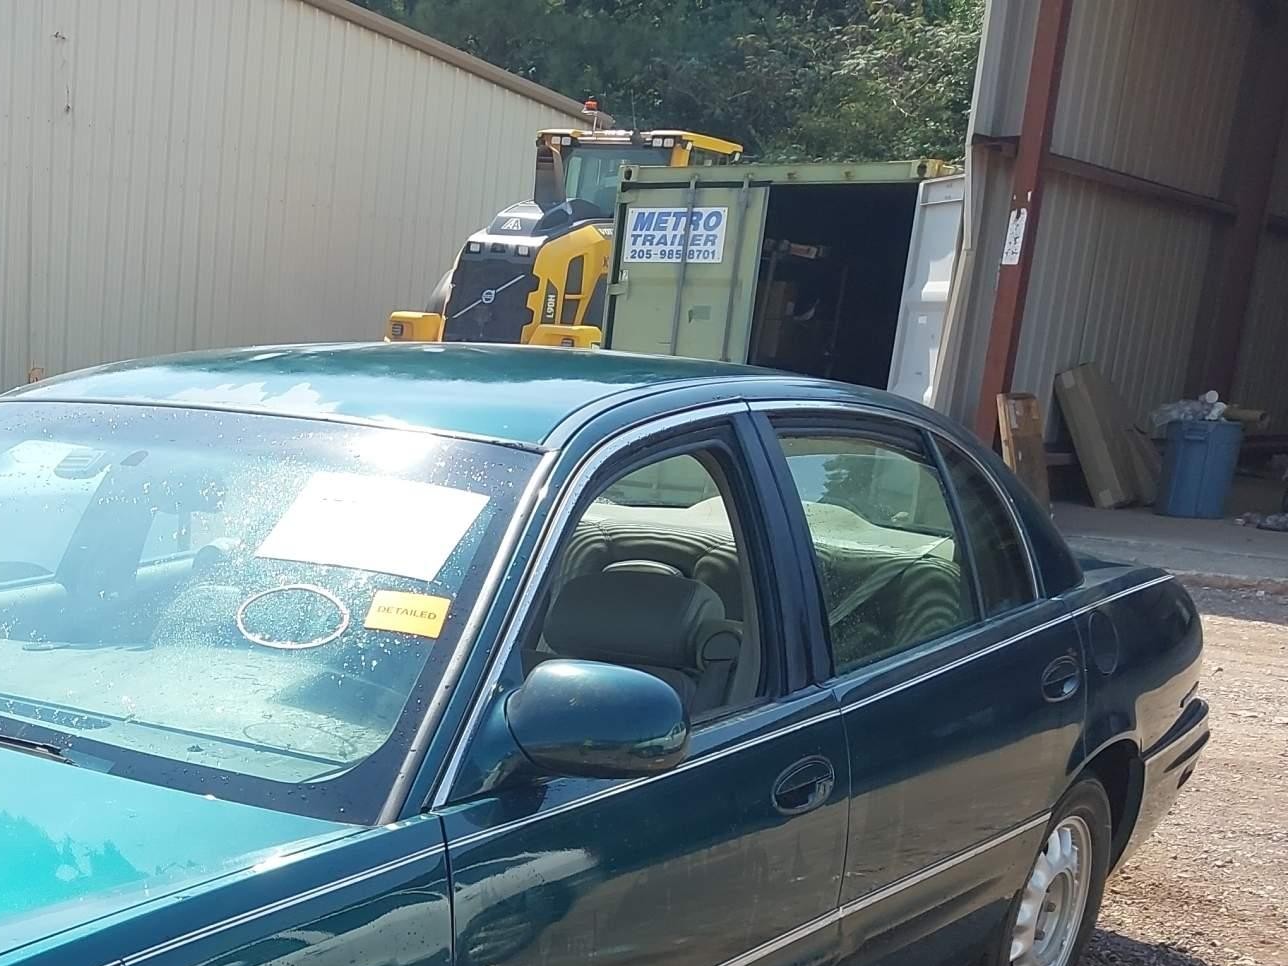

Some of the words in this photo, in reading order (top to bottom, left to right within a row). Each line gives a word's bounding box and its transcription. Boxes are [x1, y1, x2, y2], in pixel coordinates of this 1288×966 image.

[632, 211, 723, 232] METRO
[630, 249, 715, 260] 205-9858701
[546, 294, 556, 319] L90H
[377, 606, 437, 620] DETAILED
